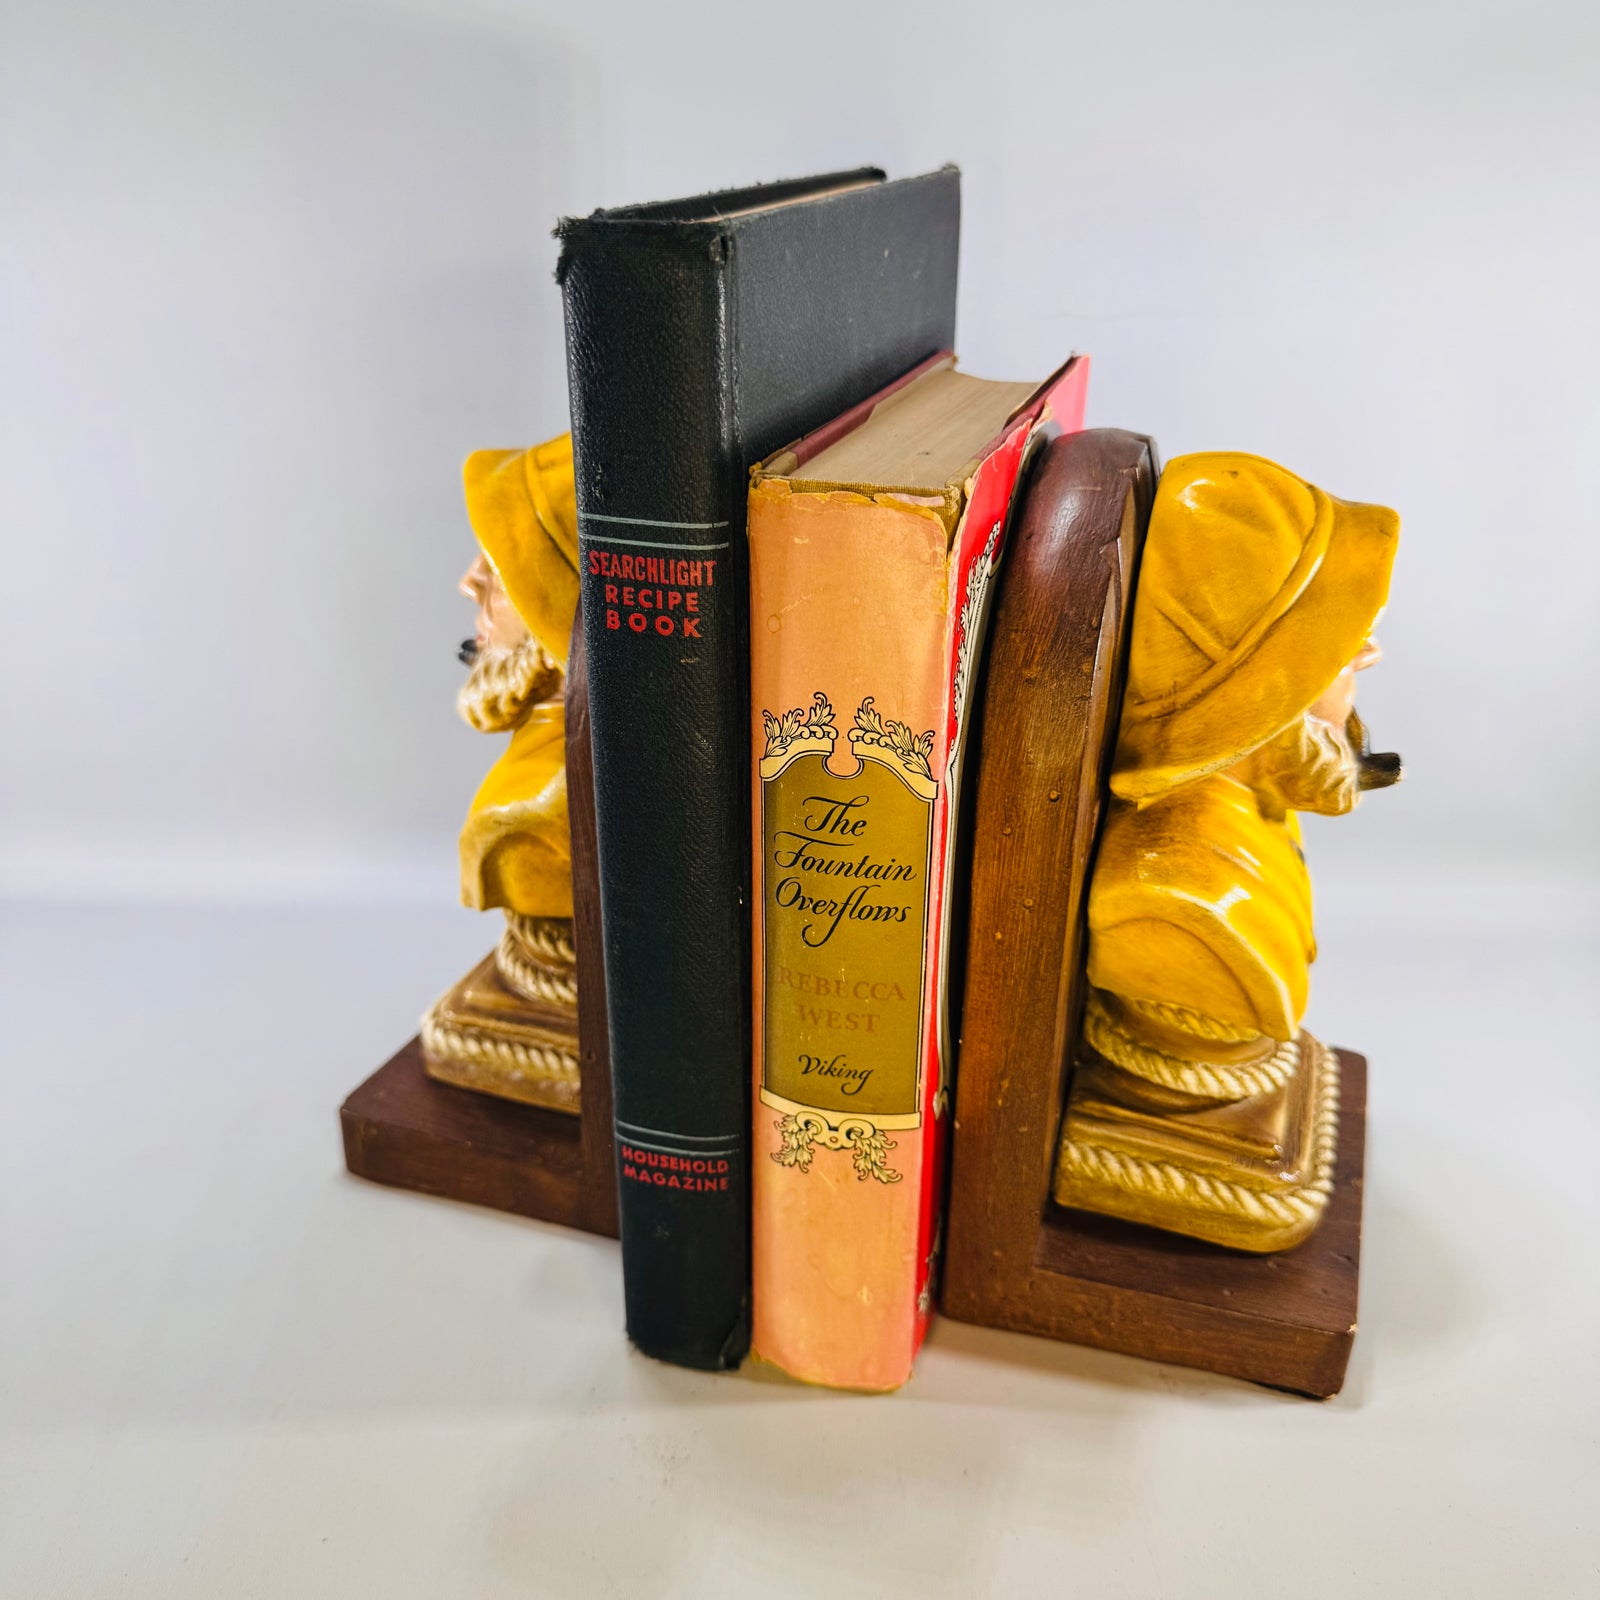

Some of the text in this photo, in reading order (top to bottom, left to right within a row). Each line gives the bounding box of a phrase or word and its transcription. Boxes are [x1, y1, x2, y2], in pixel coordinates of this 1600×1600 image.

[588, 549, 717, 586] SEARCHLIGHT
[605, 584, 700, 612] RECIPE
[606, 609, 702, 638] BOOK
[802, 795, 870, 837] The
[774, 831, 917, 881] Fountain
[775, 876, 912, 948] Overflows
[778, 965, 907, 1001] REBECCA
[797, 1004, 880, 1033] WEST
[798, 1054, 874, 1096] Viking
[621, 1144, 729, 1175] HOUSEHOLD
[623, 1164, 729, 1192] MAGAZINE
